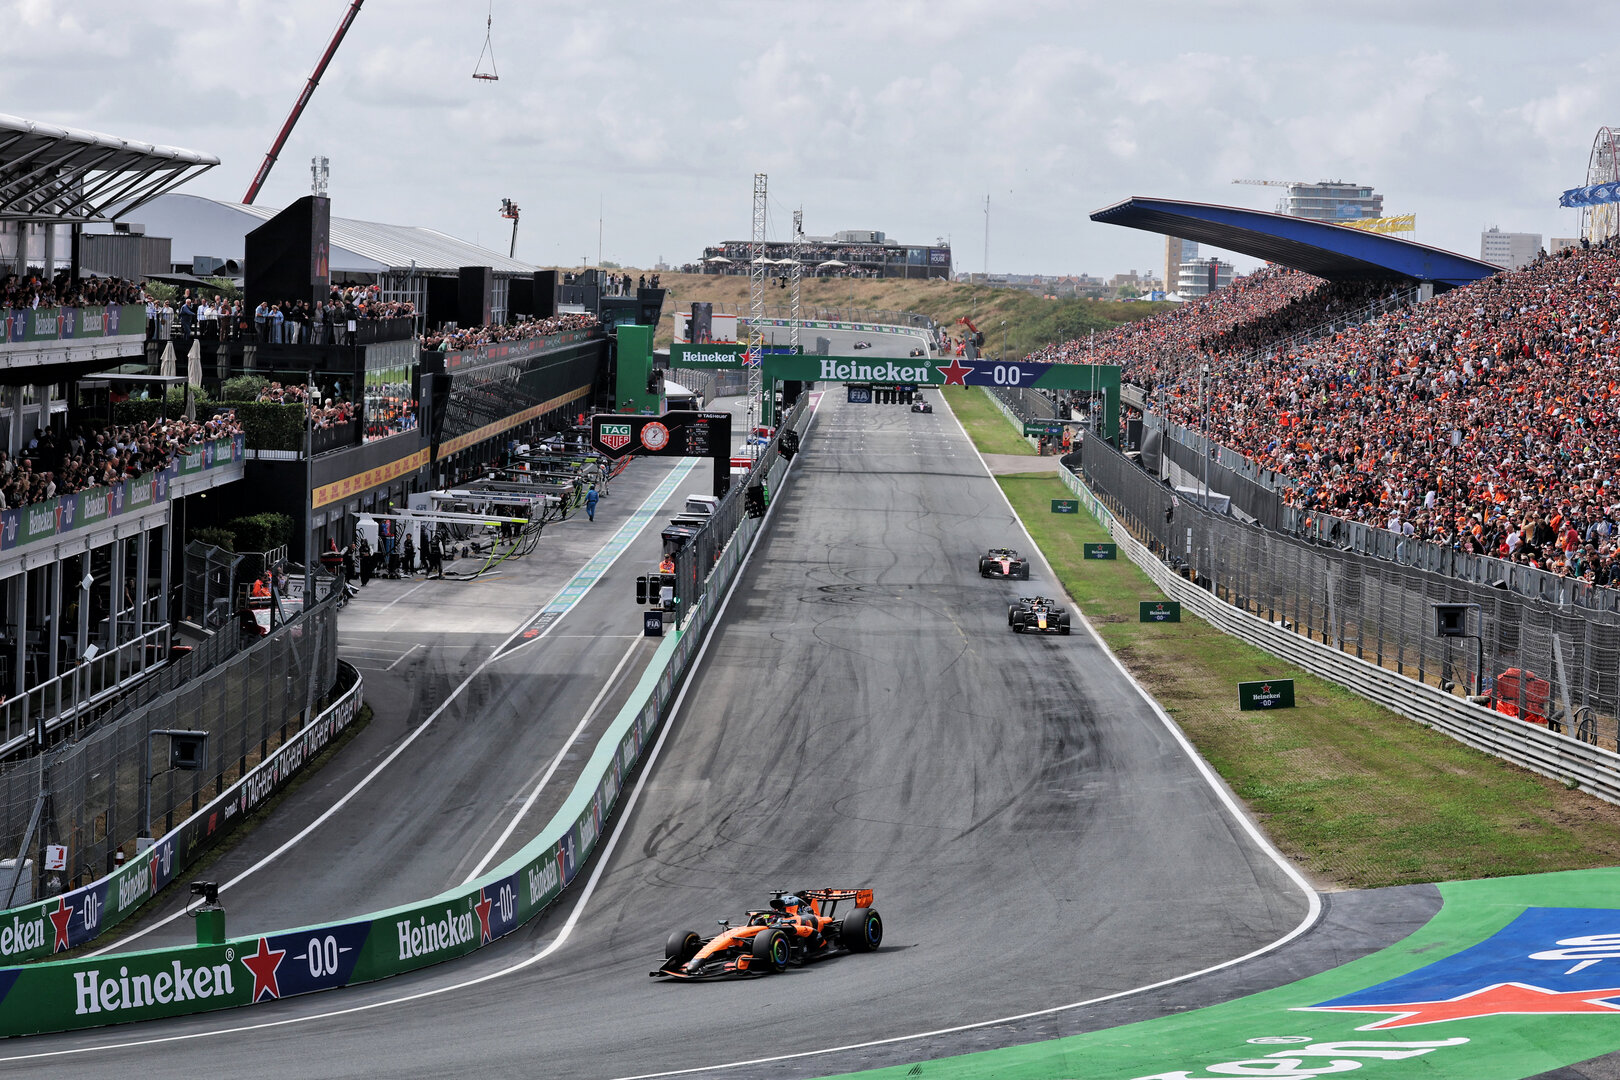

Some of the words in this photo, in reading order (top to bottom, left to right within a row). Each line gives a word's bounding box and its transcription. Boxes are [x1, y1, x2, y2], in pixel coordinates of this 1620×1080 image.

[682, 352, 735, 362] Heineken
[820, 359, 929, 382] Heineken
[993, 365, 1020, 385] 0.0
[850, 388, 870, 400] FIA
[602, 435, 629, 448] HEUER
[603, 426, 628, 434] TAG
[646, 619, 660, 628] FIA
[117, 865, 149, 913] Heineken
[529, 857, 558, 905] Heineken
[83, 891, 98, 931] 0.0
[396, 909, 475, 961] Heineken
[499, 884, 513, 923] 0.0
[74, 960, 235, 1016] Heineken
[308, 935, 339, 979] 0.0
